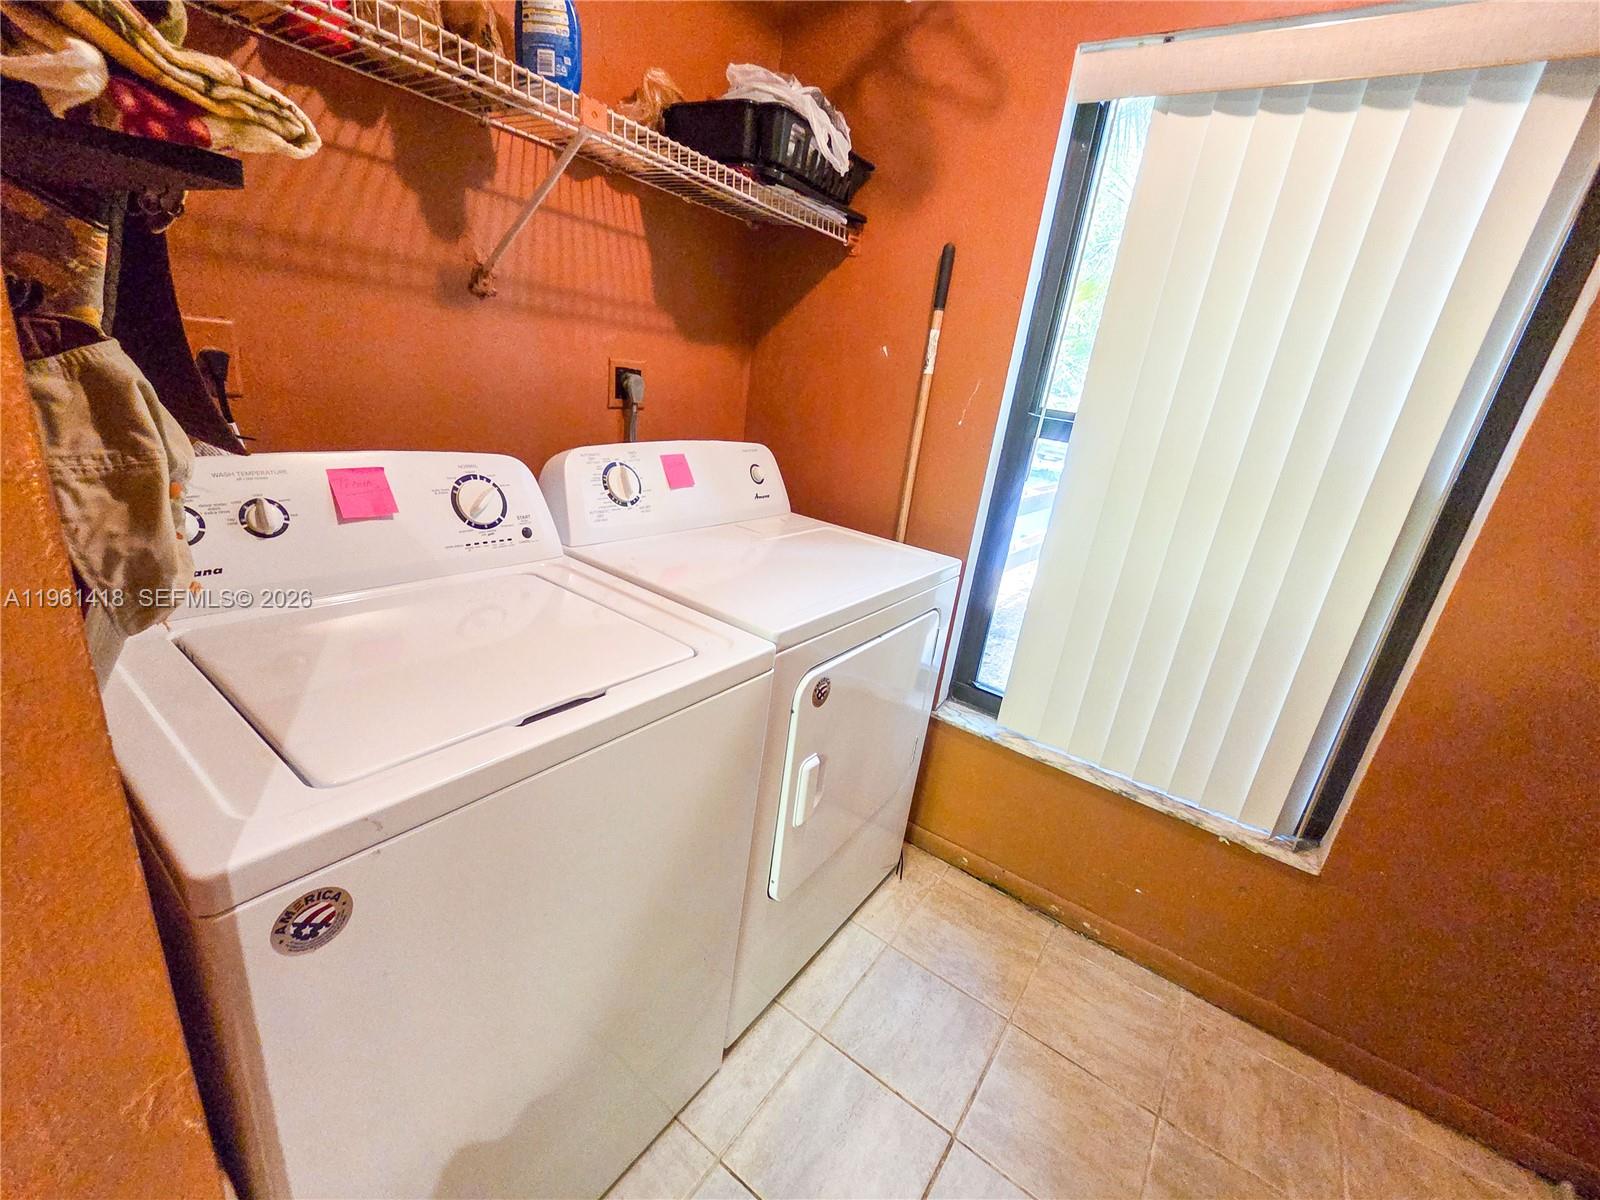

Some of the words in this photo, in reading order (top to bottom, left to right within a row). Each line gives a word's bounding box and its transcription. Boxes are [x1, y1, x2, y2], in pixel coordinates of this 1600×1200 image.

[211, 470, 236, 478] WASH
[237, 469, 288, 478] TEMPERATURE
[193, 566, 223, 578] ana
[274, 889, 342, 935] AMERICA
